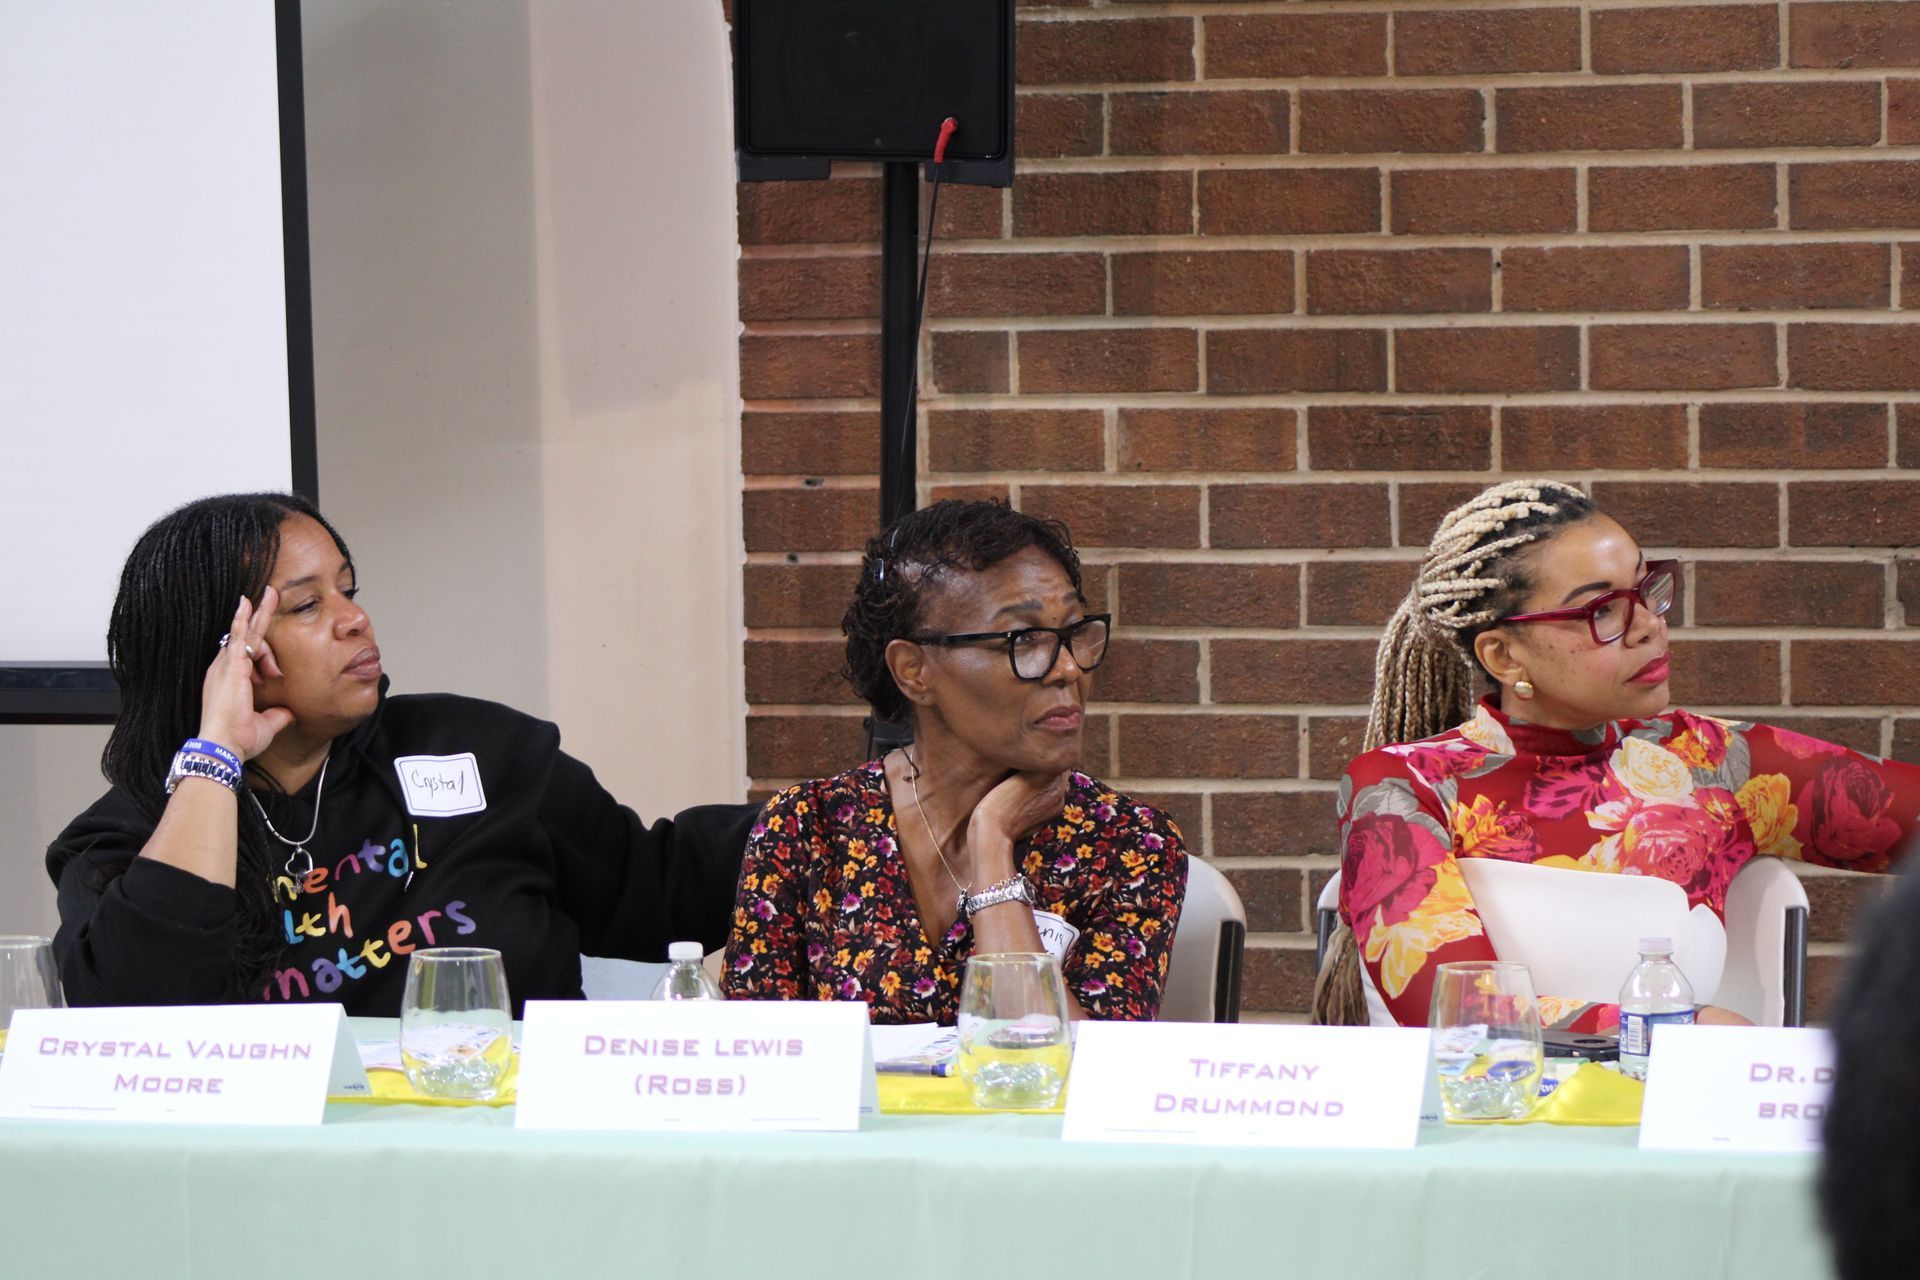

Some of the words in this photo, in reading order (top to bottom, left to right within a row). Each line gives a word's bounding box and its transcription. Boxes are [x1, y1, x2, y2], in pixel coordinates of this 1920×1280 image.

[411, 769, 464, 799] Crystal
[283, 892, 354, 945] lth
[263, 900, 477, 1002] matters
[38, 1036, 171, 1059] CRYSTAL
[186, 1040, 312, 1060] VAUGHN
[583, 1035, 700, 1057] DENISE
[715, 1038, 804, 1057] LEWIS
[1188, 1057, 1320, 1081] TIFFANY
[113, 1073, 224, 1094] MOORE
[634, 1074, 747, 1097] (ROSS)
[1153, 1094, 1345, 1118] DRUMMOND
